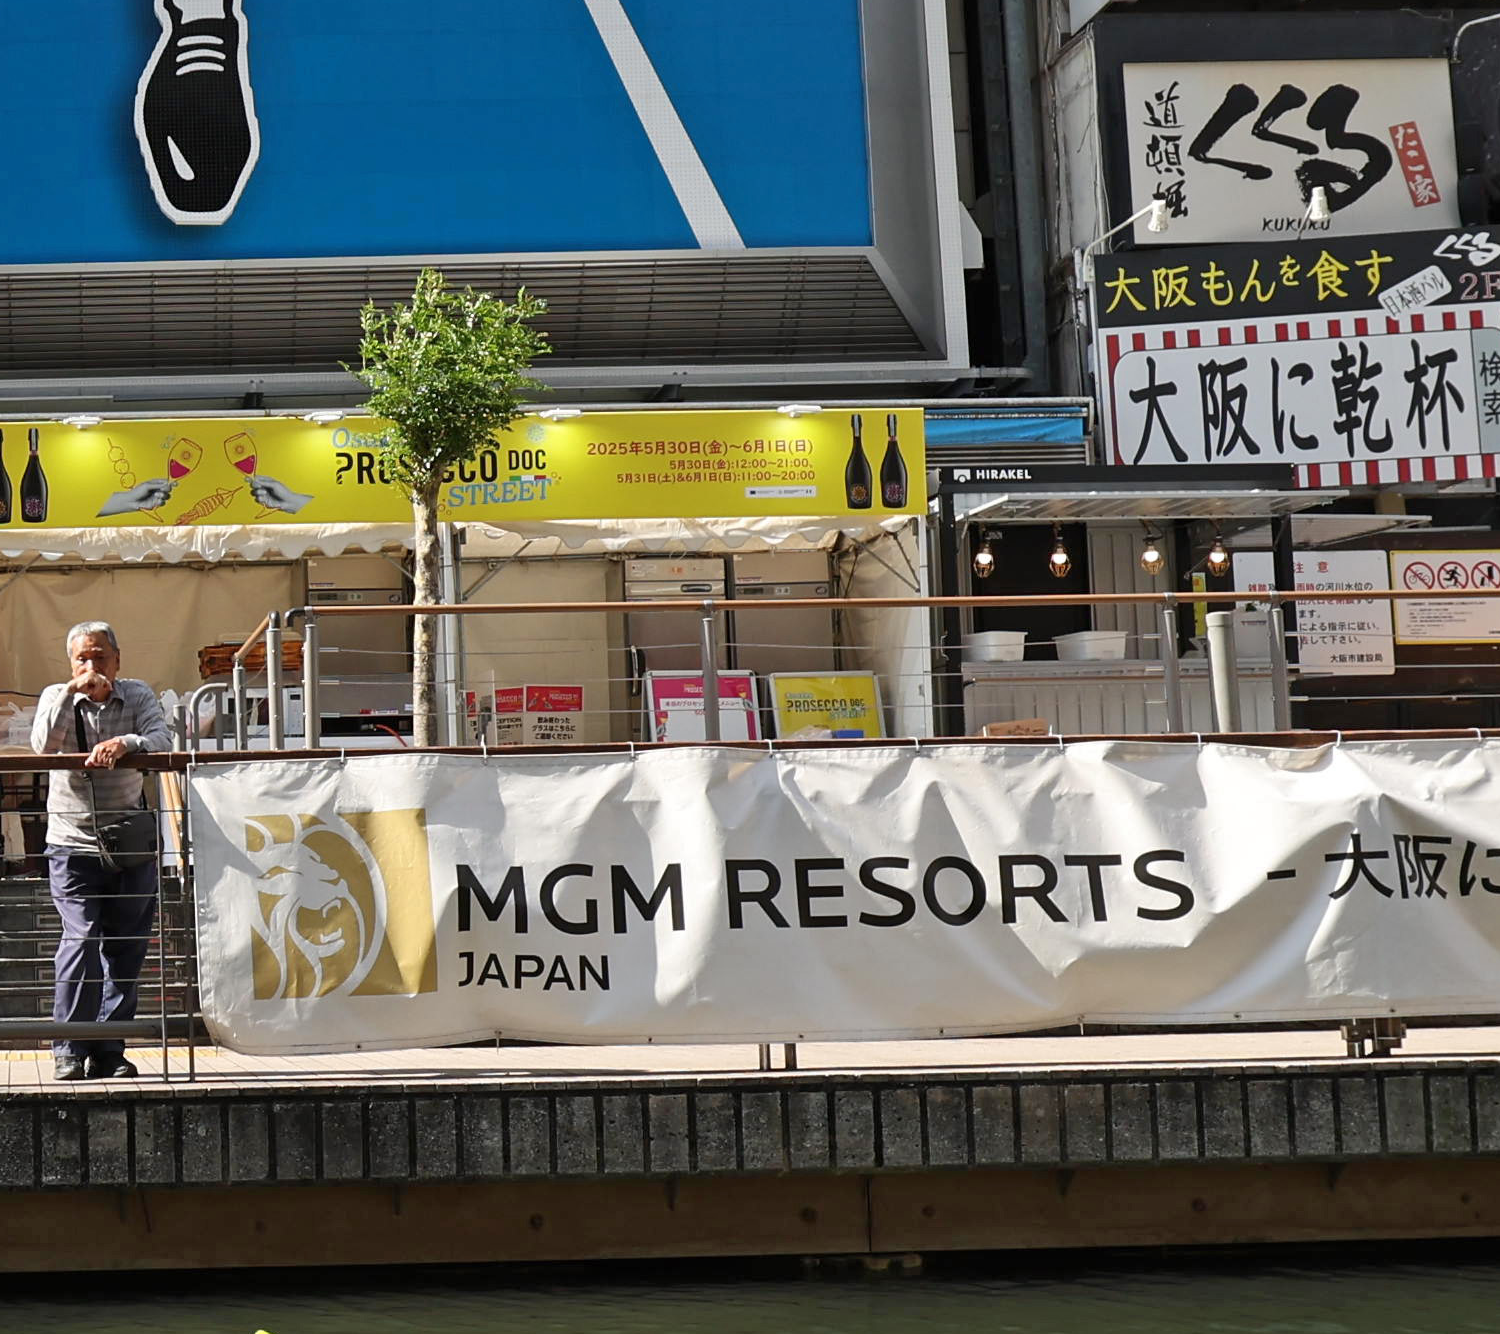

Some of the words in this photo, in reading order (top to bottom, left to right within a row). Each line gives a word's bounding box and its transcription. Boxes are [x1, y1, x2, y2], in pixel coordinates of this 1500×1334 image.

[1188, 83, 1393, 213] くくる
[1394, 125, 1437, 204] たこ家
[1105, 249, 1394, 314] 大阪もんを食す
[1130, 340, 1466, 466] 大阪に乾杯
[508, 449, 546, 470] DOC
[976, 469, 1032, 480] HIRAKEL
[448, 478, 553, 507] STREET
[786, 699, 847, 713] PROSECCO
[459, 862, 686, 935] MGM
[728, 848, 1196, 930] RESORTS
[459, 951, 610, 992] JAPAN
